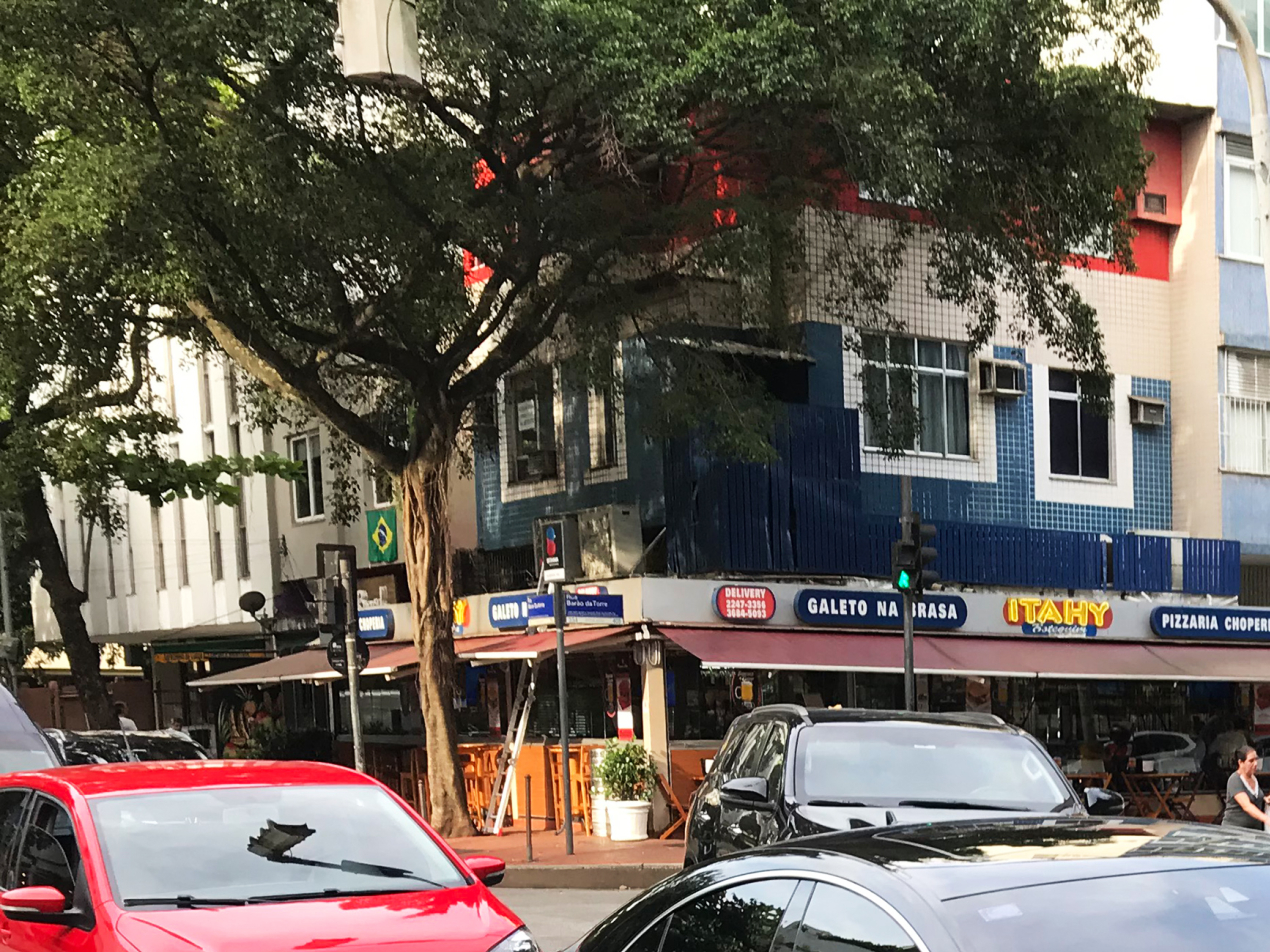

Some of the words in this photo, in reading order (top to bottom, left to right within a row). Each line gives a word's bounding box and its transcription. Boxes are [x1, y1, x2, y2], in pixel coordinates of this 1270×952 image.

[725, 587, 766, 599] DELIVERY
[492, 602, 519, 621] GALETO
[807, 598, 868, 616] GALETO
[877, 600, 899, 617] NA
[1008, 598, 1110, 627] ITAHY
[1161, 613, 1219, 631] PIZZARIA
